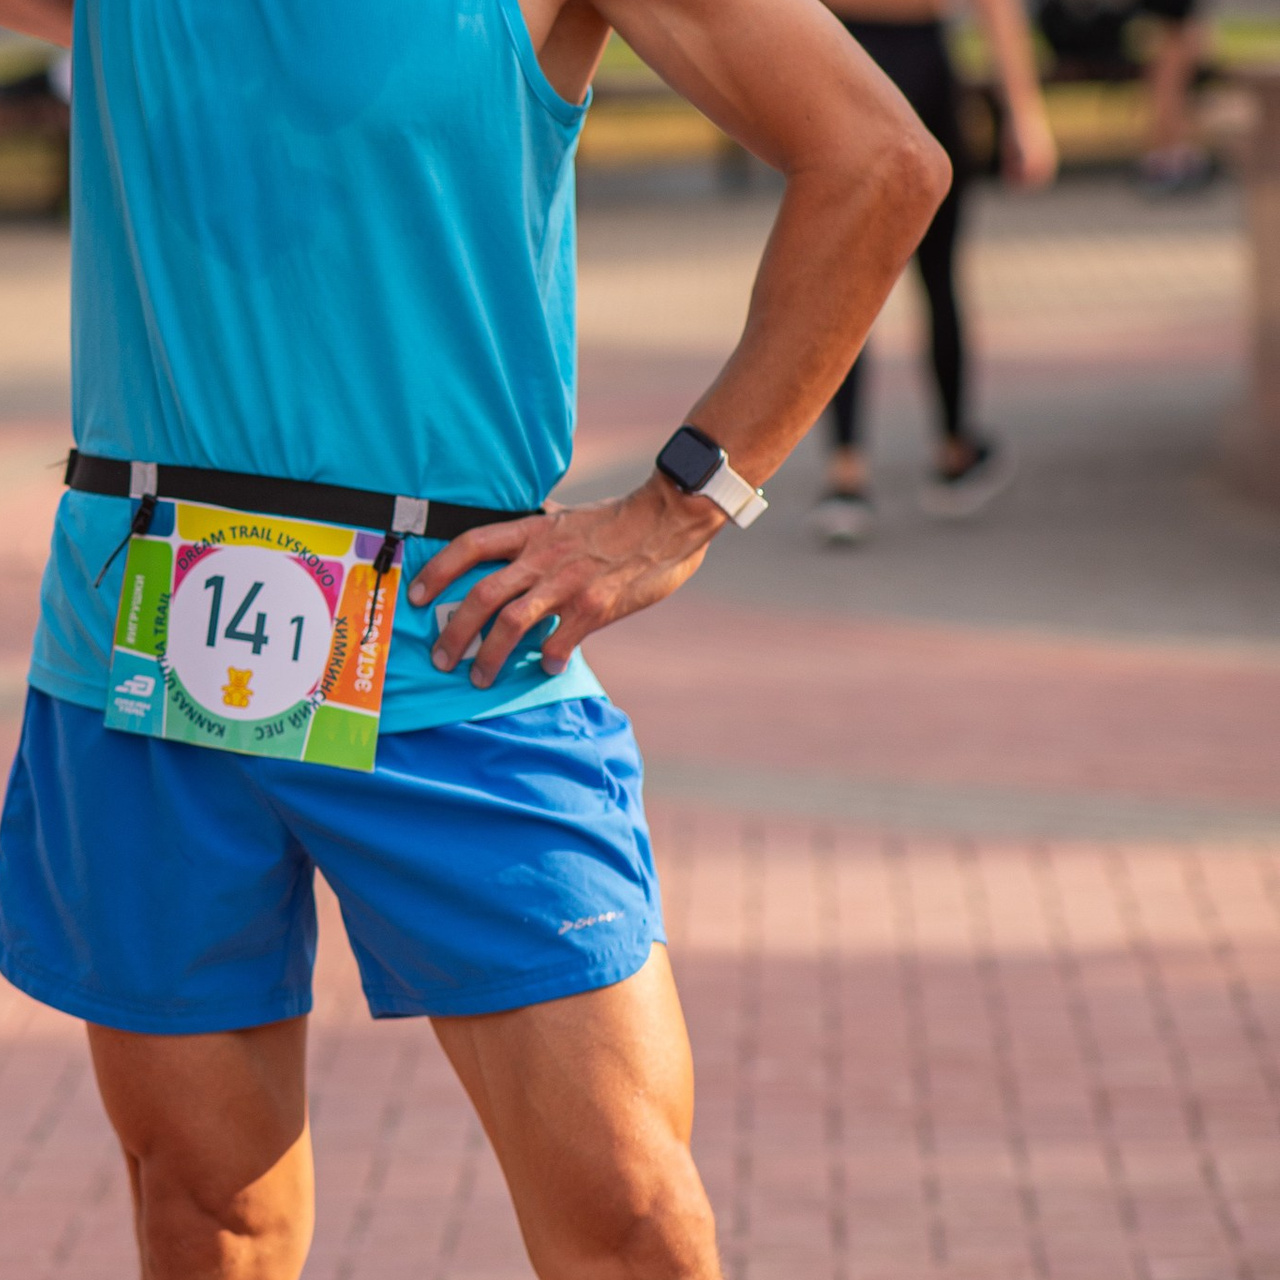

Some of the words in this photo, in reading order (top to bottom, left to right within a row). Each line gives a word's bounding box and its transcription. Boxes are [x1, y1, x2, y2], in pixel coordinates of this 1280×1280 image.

[177, 530, 225, 571] DREAM
[229, 525, 273, 543] TRAIL
[276, 531, 335, 588] LYSKOVO
[153, 592, 173, 637] TRAIL
[353, 587, 387, 693] ЭСТАФЕТА
[288, 616, 349, 729] ХИМКИНСКИЙ
[172, 689, 226, 739] KANNAS
[254, 722, 286, 741] ЛЕС
